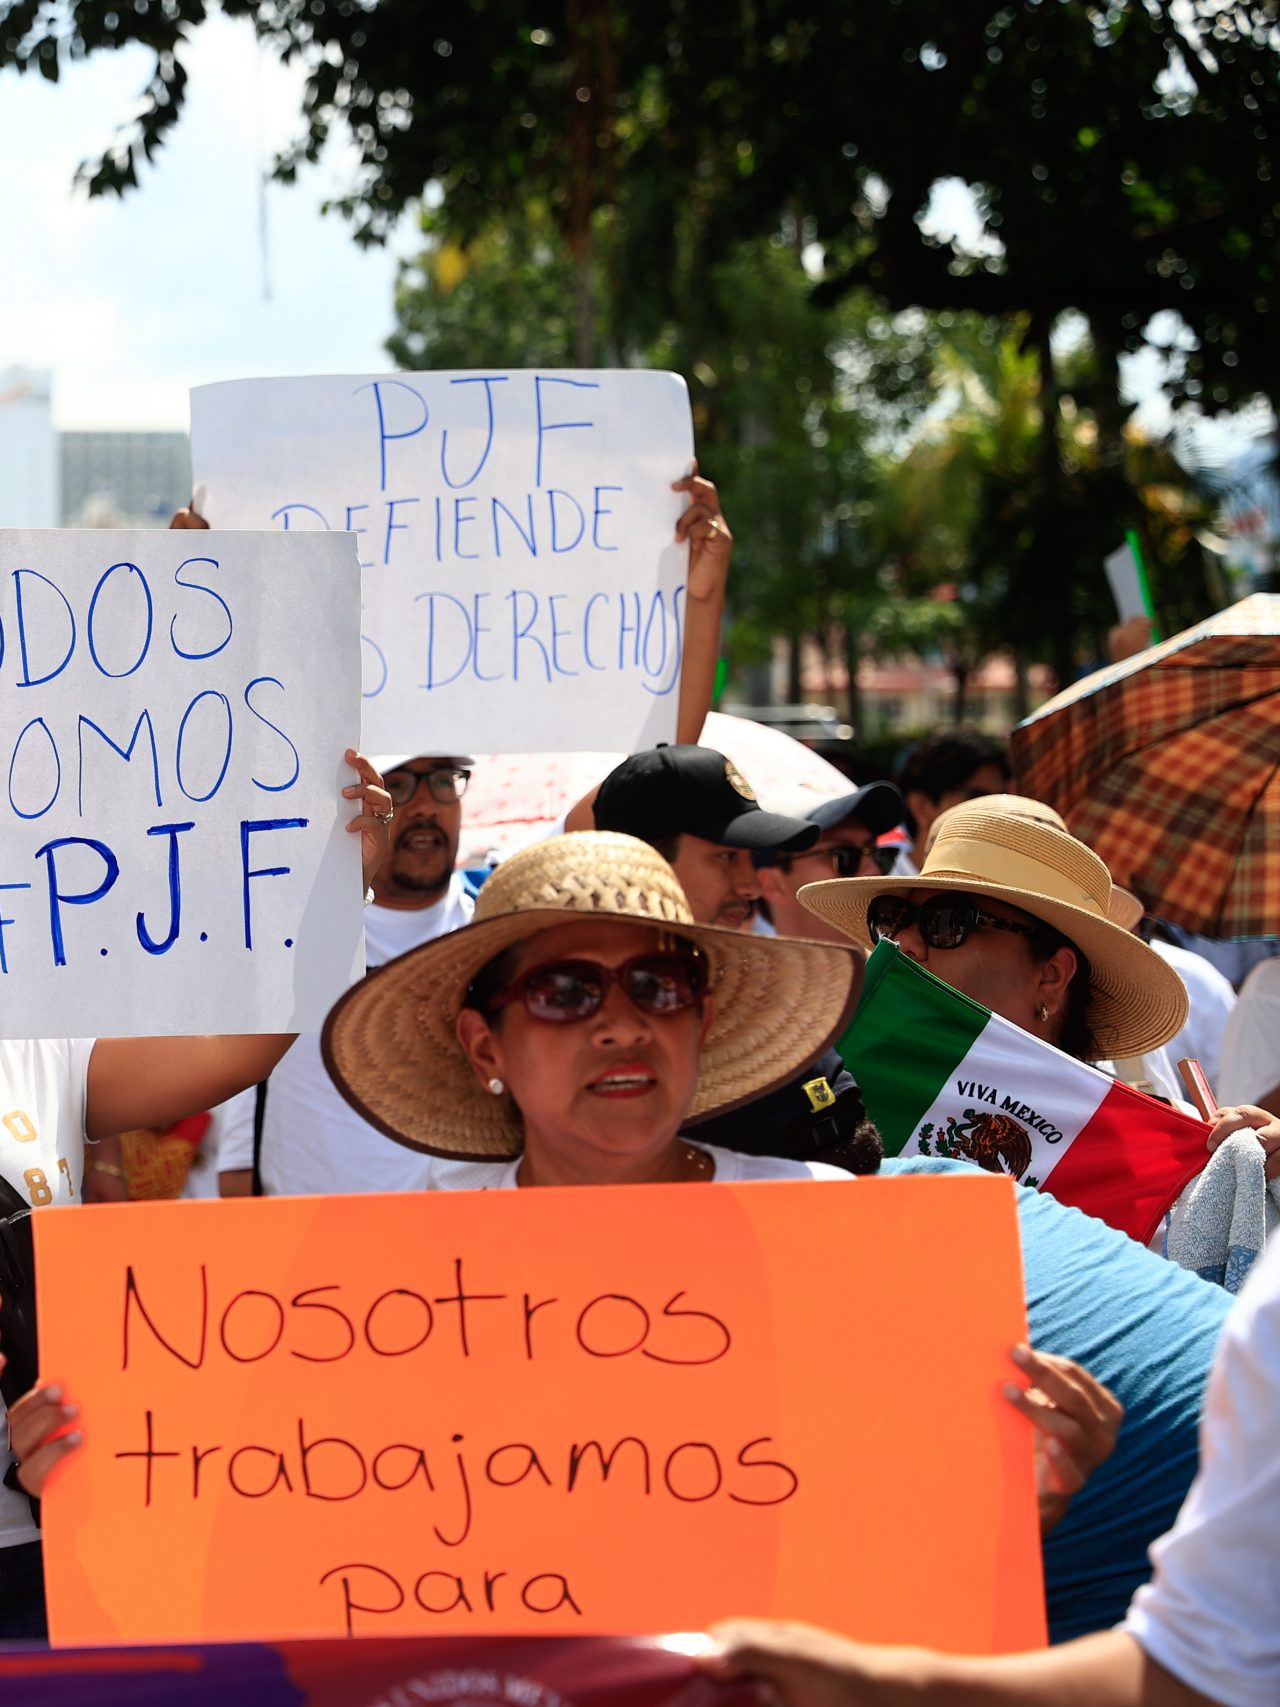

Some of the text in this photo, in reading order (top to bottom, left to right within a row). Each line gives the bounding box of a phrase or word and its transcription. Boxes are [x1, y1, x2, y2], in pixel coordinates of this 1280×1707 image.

[354, 376, 600, 491] PJF
[414, 585, 685, 695] DERECHOS
[956, 1080, 1064, 1146] VIVA MEXICO
[121, 1258, 732, 1371] Nosotros
[115, 1410, 799, 1546] trabajamos
[320, 1563, 582, 1638] para
